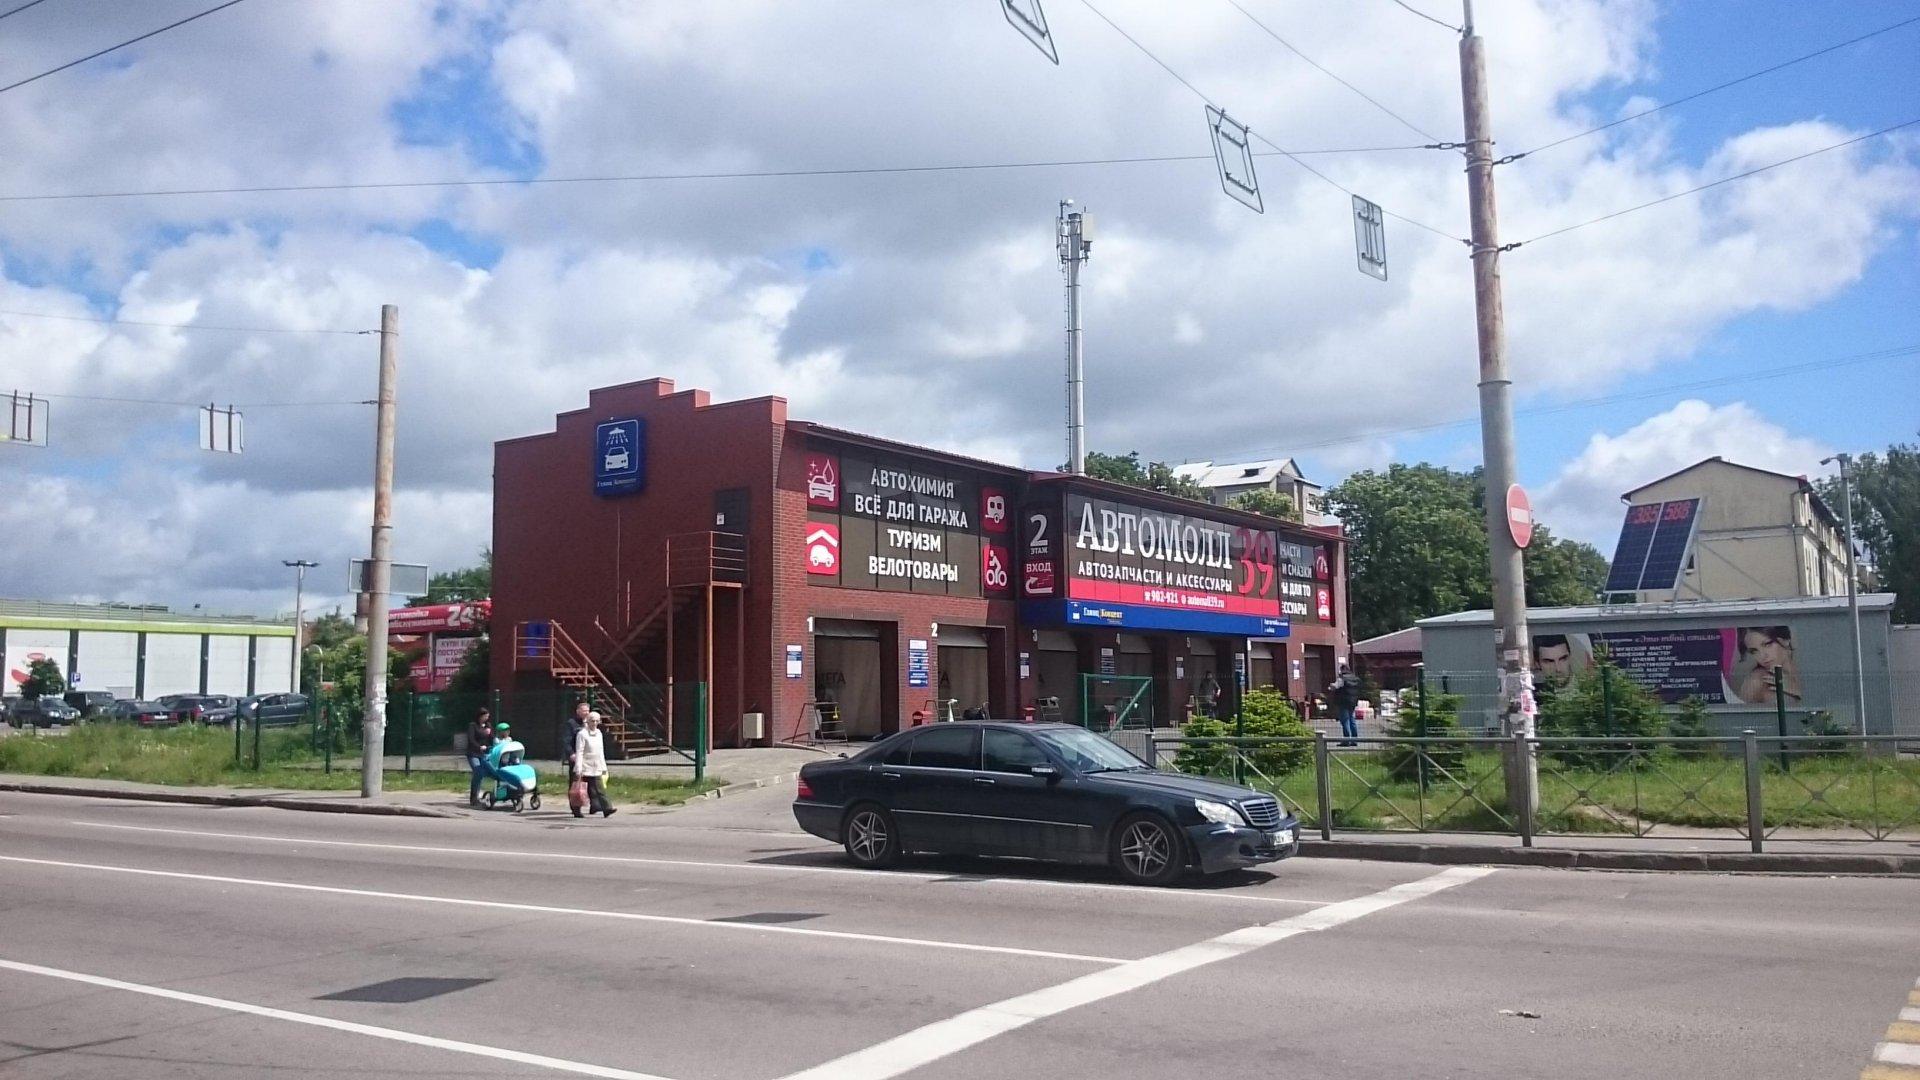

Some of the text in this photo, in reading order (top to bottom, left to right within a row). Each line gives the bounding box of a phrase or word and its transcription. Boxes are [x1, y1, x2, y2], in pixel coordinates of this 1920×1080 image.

[871, 467, 955, 499] АВТОХИМИЯ
[854, 494, 968, 529] ВСЁ ДЛЯ ГАРАЖА
[887, 528, 941, 553] ТУРИЗМ
[1030, 514, 1048, 547] 2
[1030, 547, 1048, 555] ЭТАЖ
[1076, 502, 1274, 597] АВТОМОЛЛ 39
[868, 555, 958, 582] ВЕЛОТОВАРЫ
[1026, 562, 1052, 573] ВХОД
[1078, 560, 1232, 592] АВТОЗАПЧАСТИ И АКСЕССУАРЫ
[1288, 563, 1313, 579] СМАЗКИ
[807, 616, 814, 632] 1
[931, 622, 938, 637] 2
[1032, 629, 1038, 642] 3
